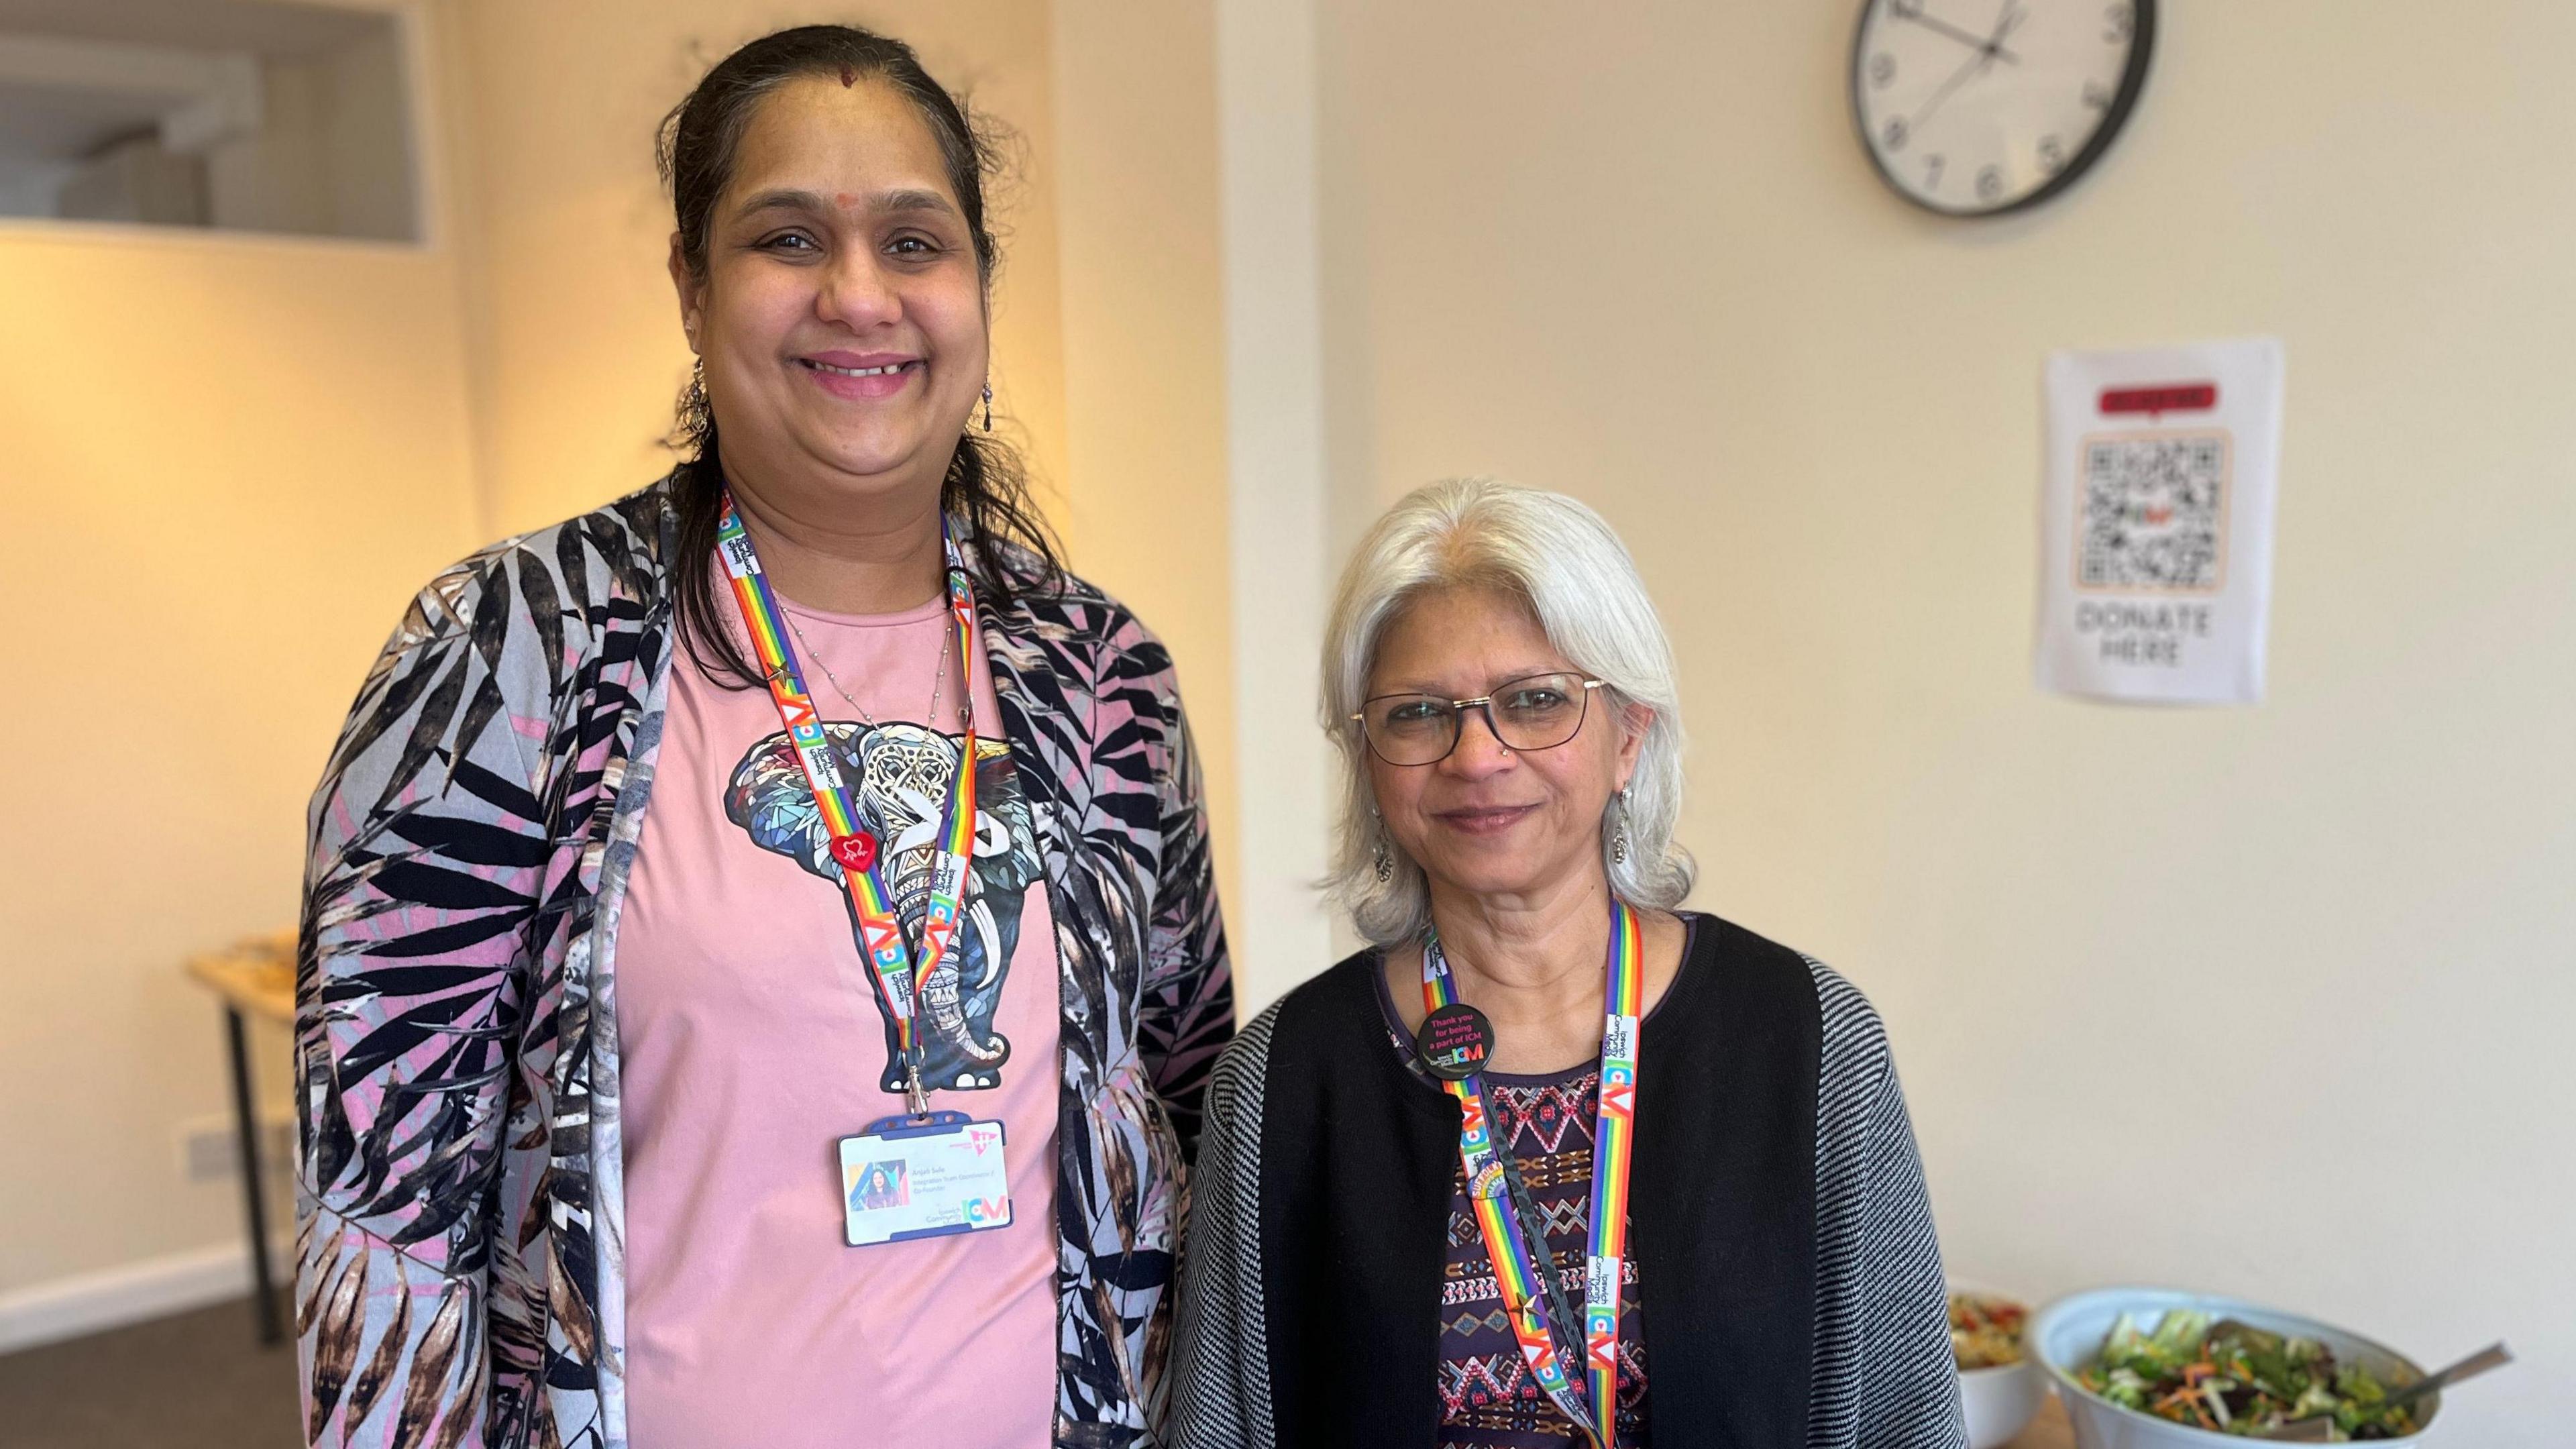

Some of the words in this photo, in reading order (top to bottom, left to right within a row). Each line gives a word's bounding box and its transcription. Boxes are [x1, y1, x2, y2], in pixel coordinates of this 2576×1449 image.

[727, 539, 742, 564] Ipswich
[735, 537, 754, 576] Community
[2076, 602, 2212, 637] DONATE
[2100, 638, 2180, 666] HERE
[780, 693, 828, 749] ICM
[809, 749, 823, 775] Ipswich
[816, 748, 836, 789] Community
[938, 852, 953, 894] Community
[945, 869, 957, 896] Ipswich
[923, 892, 957, 956] ICM
[863, 912, 908, 975] ICM
[891, 973, 905, 1002] Ipswich
[899, 973, 912, 1017] Community
[1431, 1016, 1456, 1028] Thank
[1457, 1014, 1473, 1023] you
[1449, 1024, 1472, 1034] being
[1611, 1014, 1622, 1058] Community
[1436, 1038, 1454, 1049] part
[1455, 1035, 1464, 1044] of
[1465, 1031, 1482, 1042] ICM
[1452, 1043, 1485, 1064] ICM
[1604, 1033, 1613, 1057] Media
[1619, 1030, 1627, 1059] Ipswich
[1600, 1059, 1633, 1118] ICM
[961, 1195, 1008, 1222] ICM
[1587, 1277, 1595, 1303] Media
[1593, 1255, 1604, 1304] Community
[1601, 1274, 1609, 1304] Ipswich
[1587, 1307, 1615, 1370] ICM
[1521, 1328, 1568, 1391] ICM
